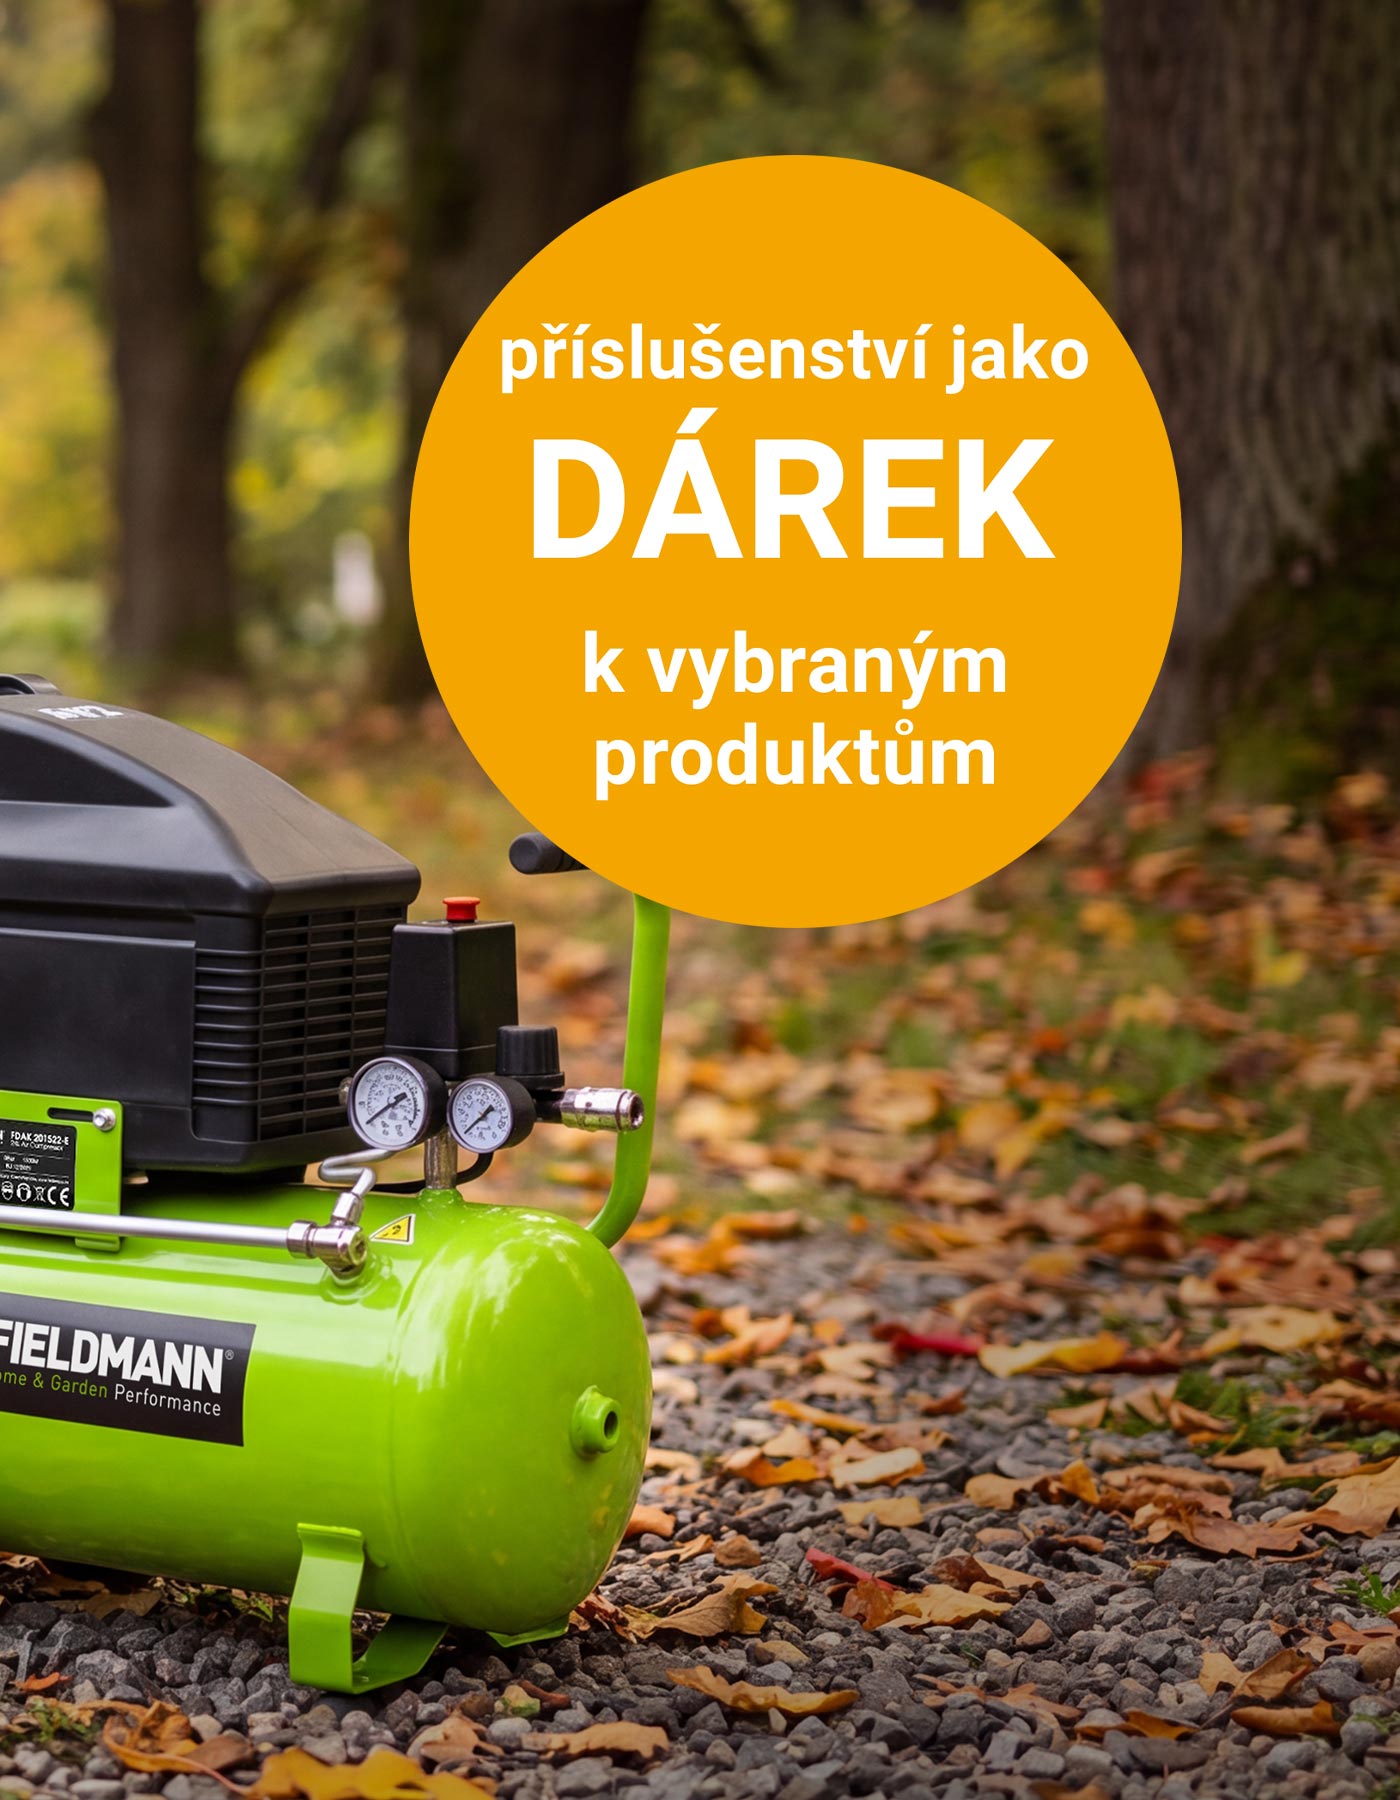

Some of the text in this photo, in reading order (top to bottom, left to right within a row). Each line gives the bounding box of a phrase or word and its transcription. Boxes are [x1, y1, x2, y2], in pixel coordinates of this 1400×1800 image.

[32, 1371, 44, 1389] &
[51, 1374, 108, 1399] Garden
[114, 1383, 222, 1417] Performance
